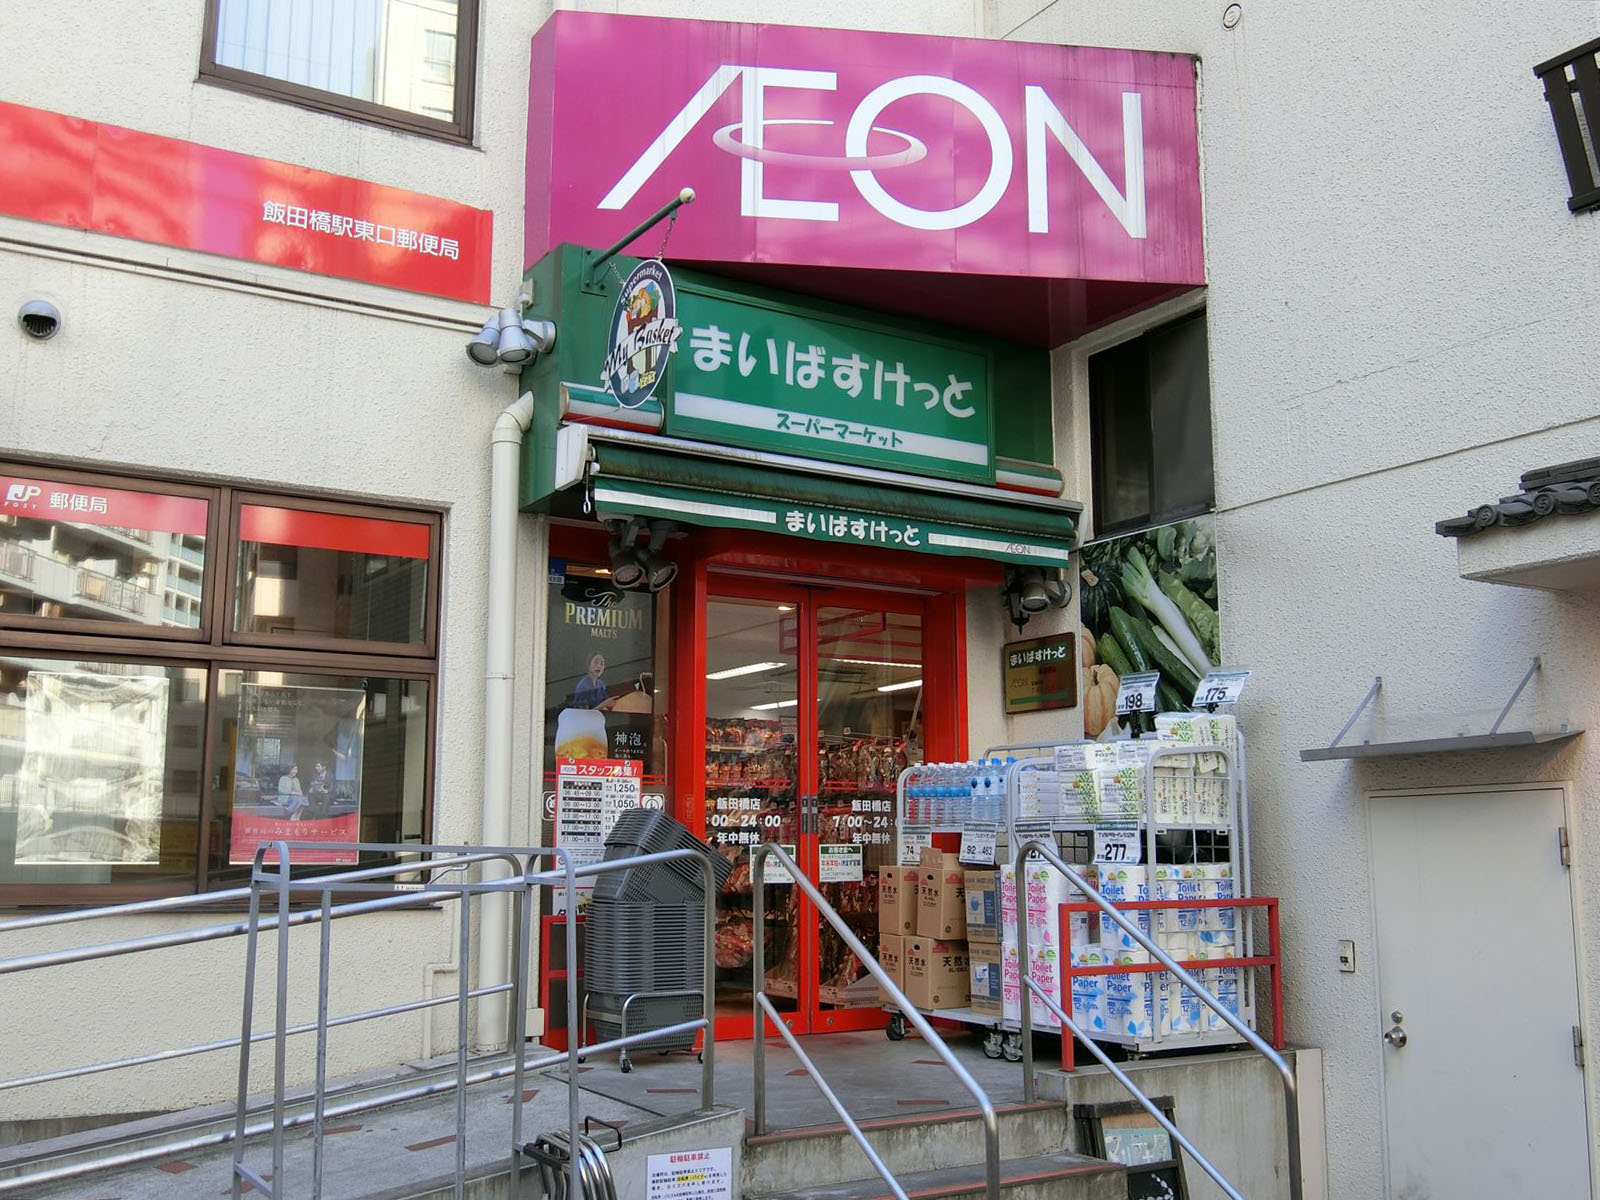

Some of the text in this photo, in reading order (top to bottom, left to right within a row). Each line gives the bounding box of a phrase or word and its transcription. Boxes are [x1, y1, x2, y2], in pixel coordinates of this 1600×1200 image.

[263, 201, 460, 260] 飯田橋駅東口郵便局
[620, 264, 662, 305] supermarket
[604, 318, 675, 376] My Basket
[690, 325, 976, 418] まいばすけっと
[776, 413, 903, 448] スーパーマーケット
[4, 501, 38, 510] POST
[49, 492, 108, 514] 郵便局
[785, 510, 921, 546] まいばすけっと
[585, 588, 617, 607] The
[565, 602, 643, 630] PREMIUM
[1010, 646, 1066, 666] まいばすけっと
[1205, 687, 1228, 701] 175
[1125, 693, 1143, 709] 198
[613, 784, 635, 793] 1,250
[612, 799, 634, 809] 1,050
[717, 797, 761, 811] 飯田橋店
[851, 799, 891, 812] 飯田橋店
[706, 815, 781, 827] :00～24:00
[832, 816, 898, 828] 7:00～24:
[717, 831, 761, 844] 年中無休
[852, 832, 891, 844] 年中無休
[906, 845, 914, 856] 74
[967, 845, 976, 855] 92
[1104, 843, 1126, 861] 277
[882, 885, 897, 894] 天然水
[921, 886, 939, 897] 天然水
[1002, 882, 1017, 892] Toile
[1028, 882, 1046, 894] Toilet
[1101, 884, 1125, 895] Toilet
[1216, 881, 1233, 892] Toile
[1028, 893, 1047, 904] Paper
[883, 953, 899, 962] 天然水
[908, 956, 927, 966] 天然水
[1032, 960, 1053, 974] Toilet
[1032, 972, 1054, 984] Paper
[1073, 976, 1099, 988] Paper
[1107, 980, 1132, 992] Paper
